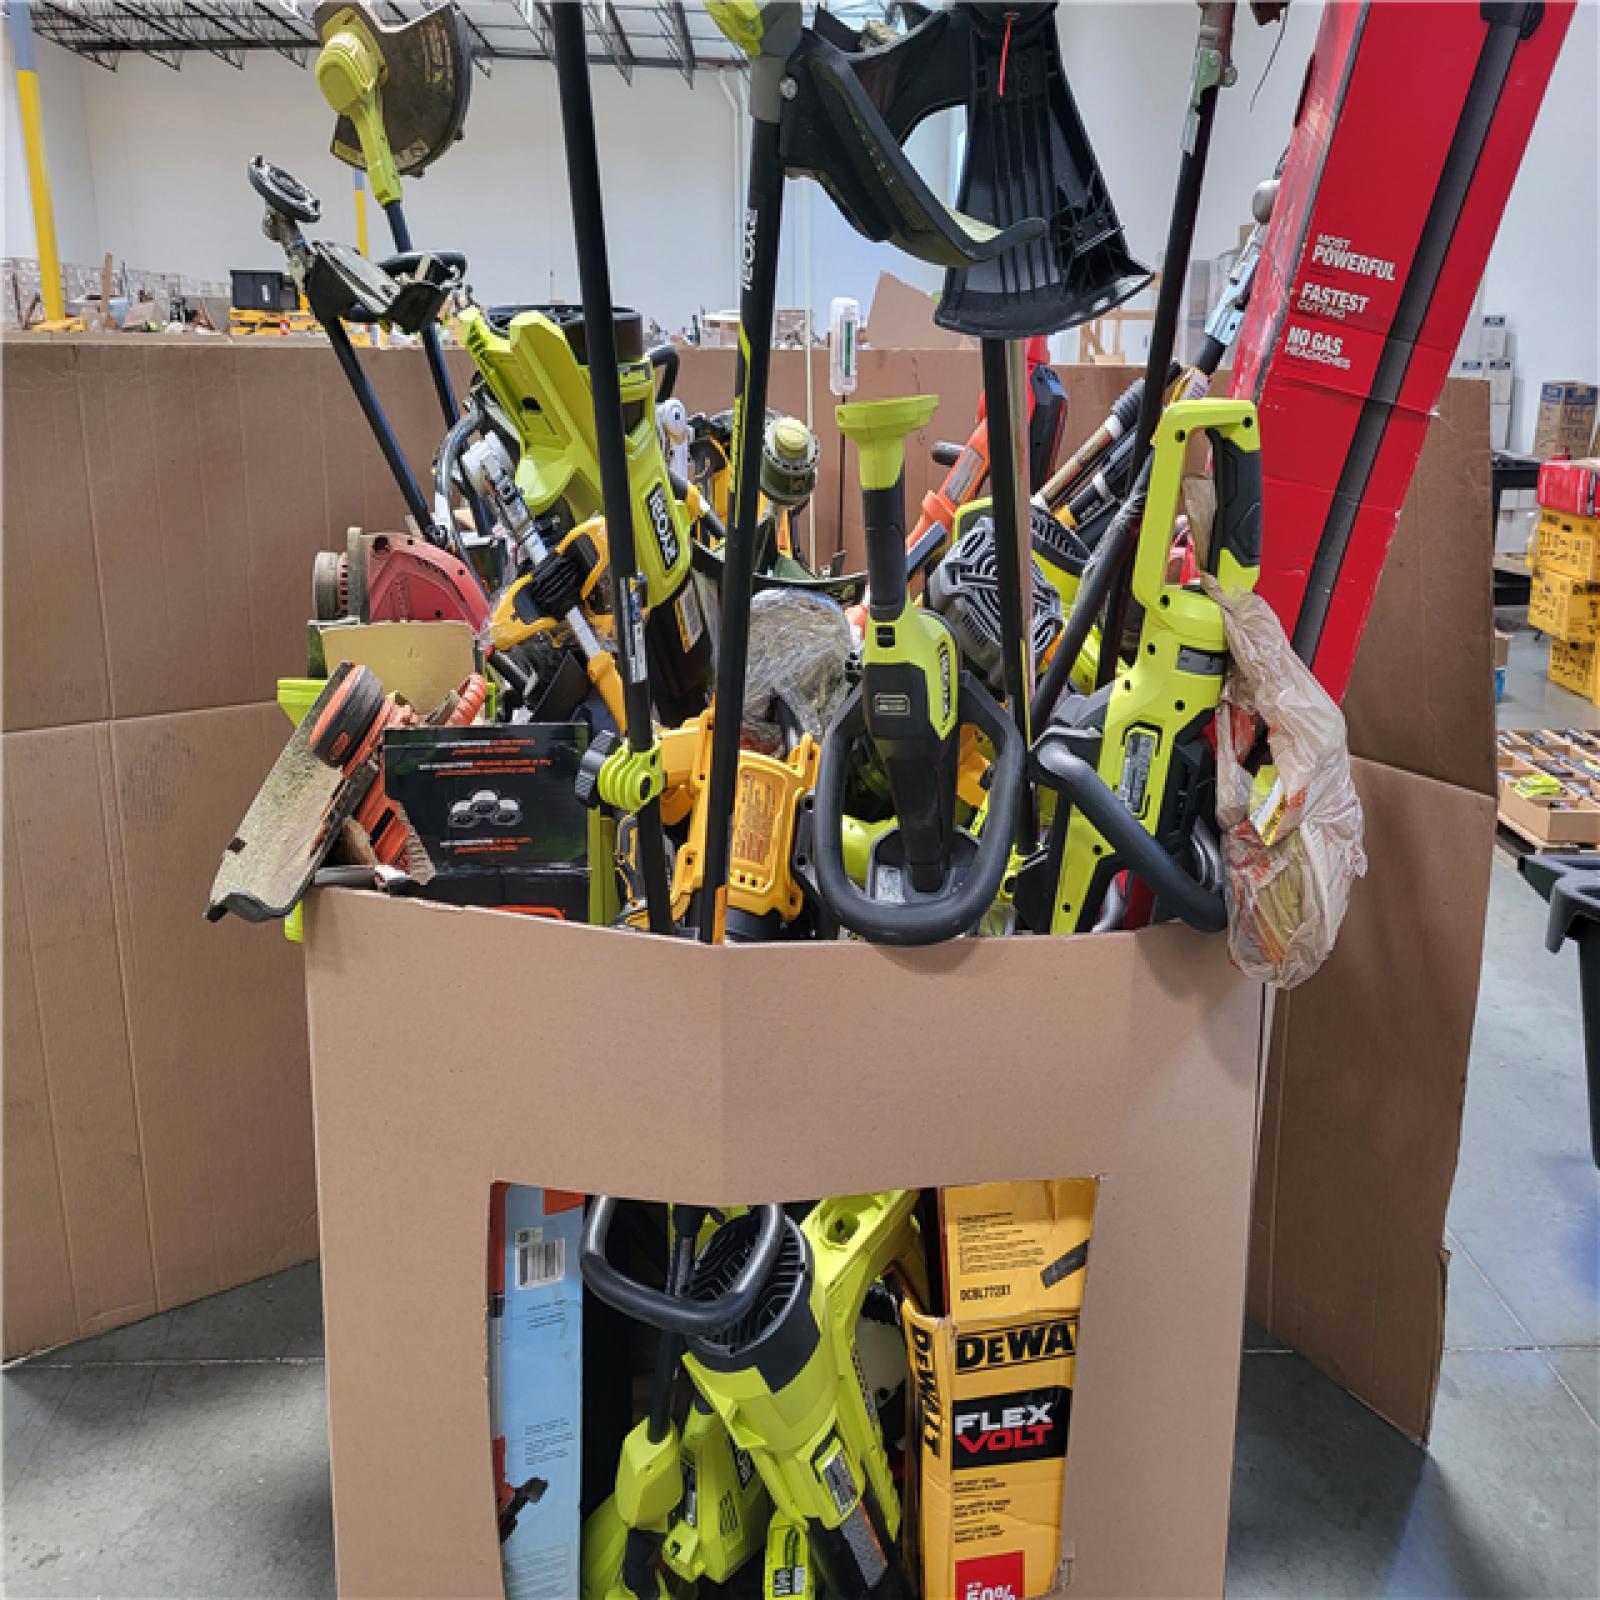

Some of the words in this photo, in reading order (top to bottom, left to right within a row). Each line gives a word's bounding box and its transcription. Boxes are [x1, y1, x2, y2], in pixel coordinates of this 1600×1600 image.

[1312, 244, 1396, 281] POWERFUL
[1302, 282, 1369, 313] FASTEST
[1288, 326, 1310, 345] NO
[1312, 331, 1344, 356] GAS
[911, 1324, 942, 1457] DEWALT
[954, 1402, 1054, 1436] FLEX
[956, 1423, 1054, 1454] VOLT
